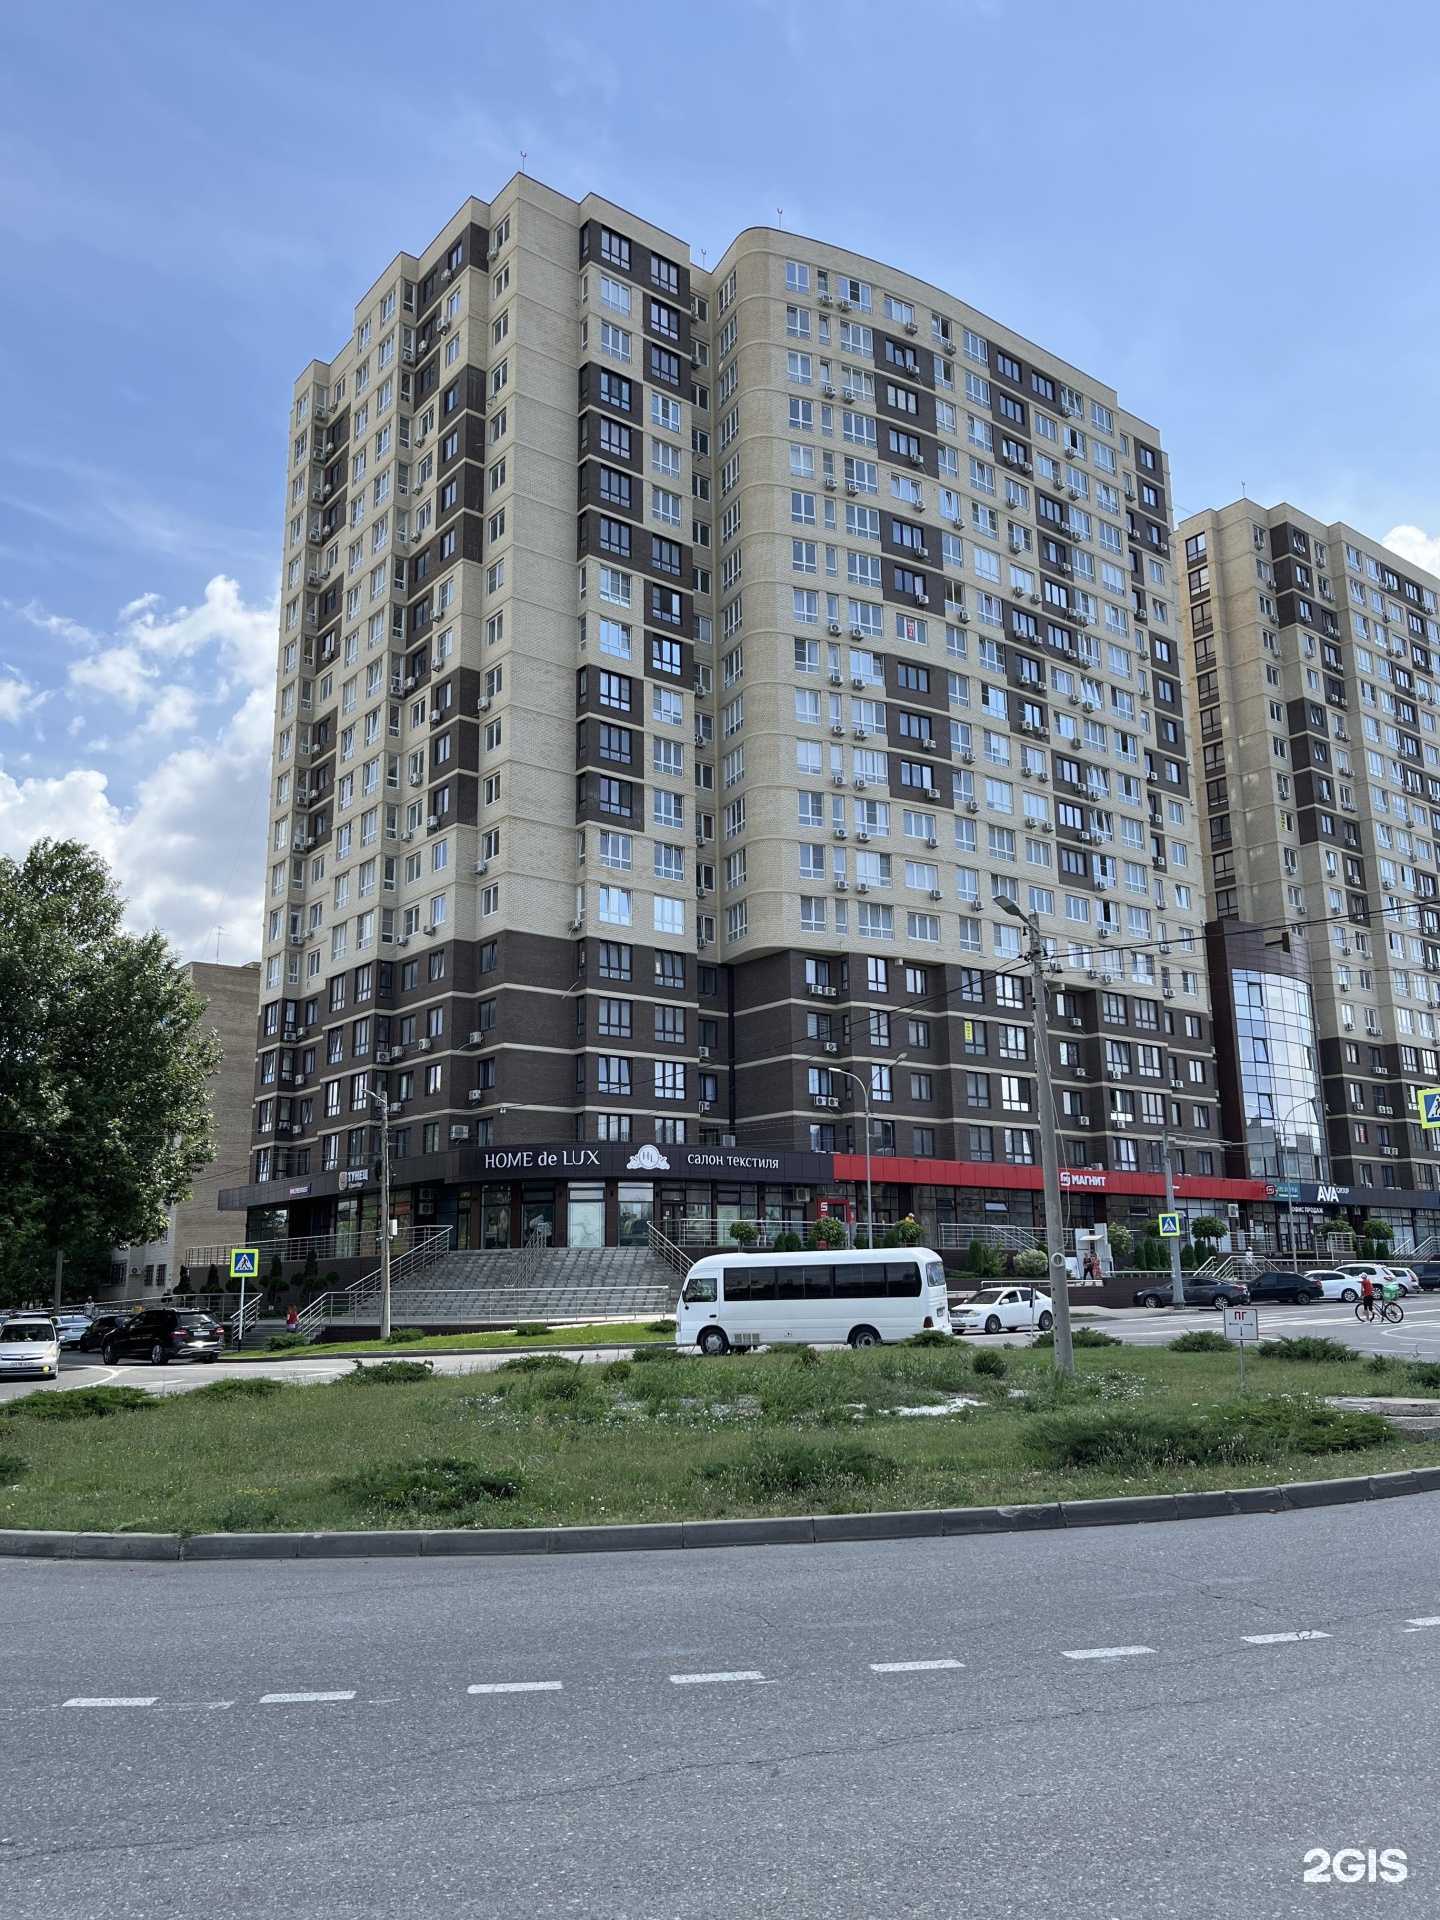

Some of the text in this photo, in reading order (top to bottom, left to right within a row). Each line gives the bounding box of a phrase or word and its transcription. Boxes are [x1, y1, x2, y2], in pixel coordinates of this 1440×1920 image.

[484, 1149, 601, 1169] HOME de LUX
[687, 1153, 779, 1169] салон текстиля
[1071, 1174, 1106, 1187] МАГНИТ
[1316, 1185, 1340, 1203] AVA
[1234, 1311, 1247, 1321] ПГ
